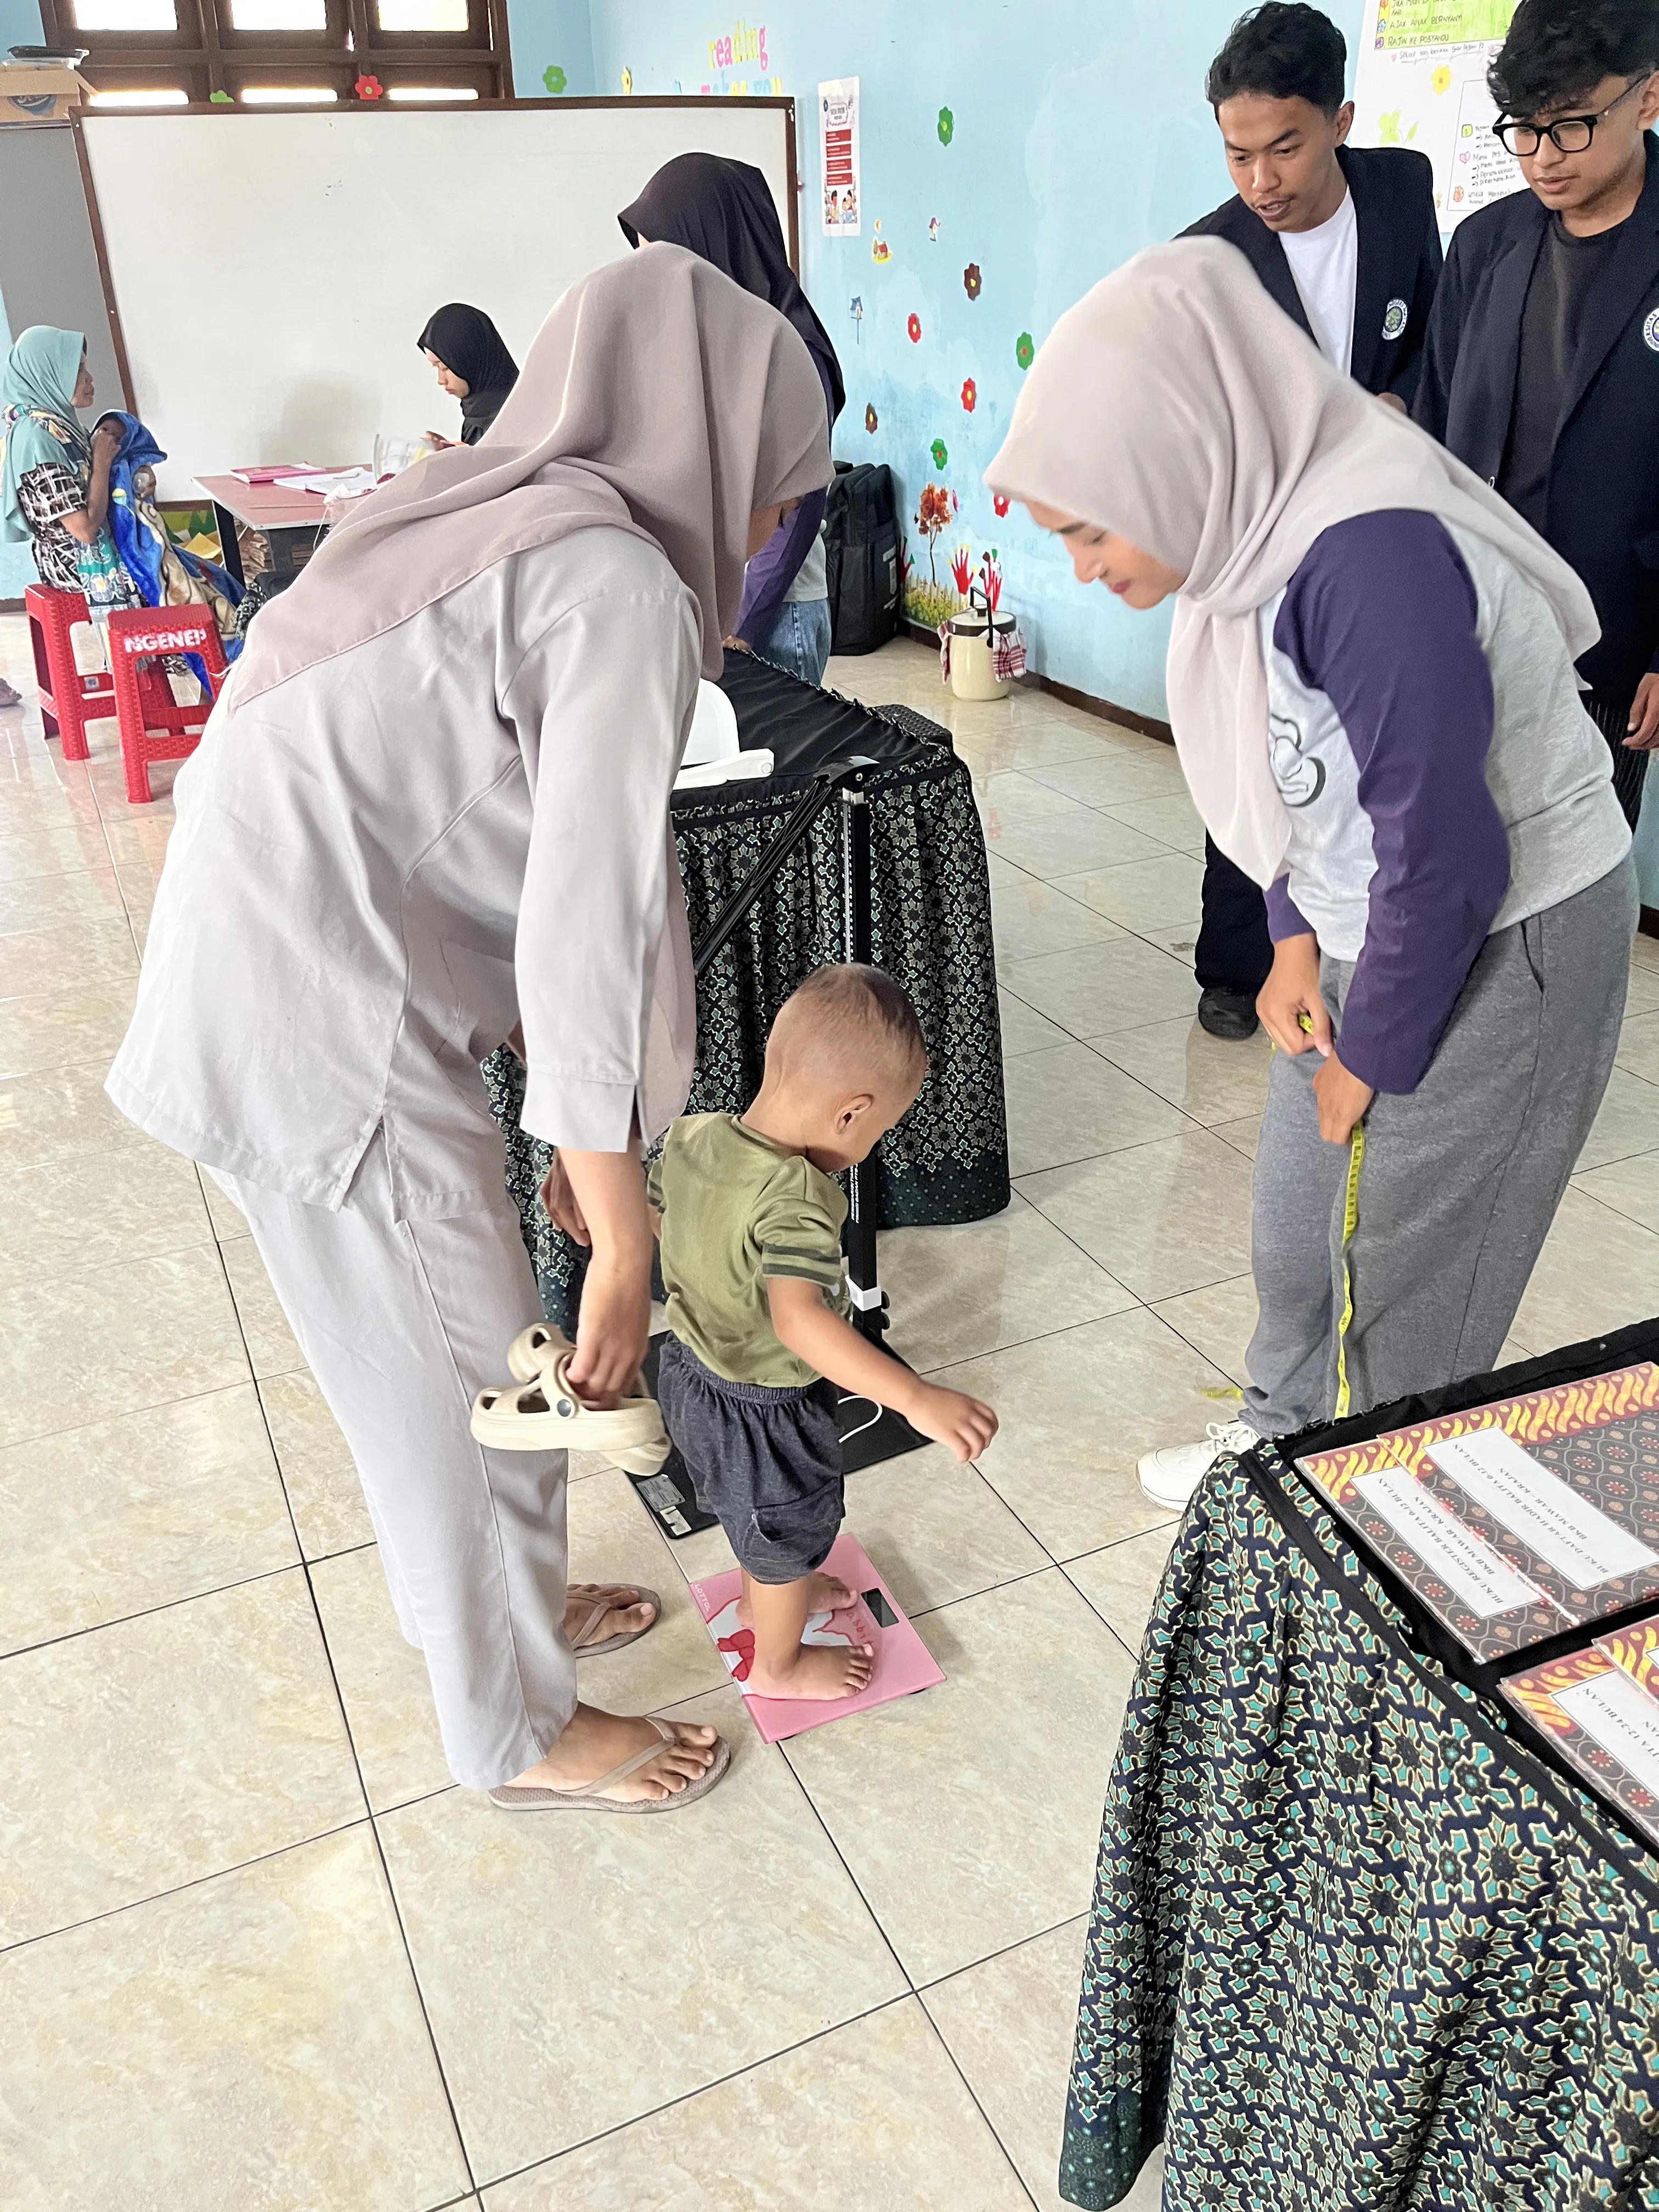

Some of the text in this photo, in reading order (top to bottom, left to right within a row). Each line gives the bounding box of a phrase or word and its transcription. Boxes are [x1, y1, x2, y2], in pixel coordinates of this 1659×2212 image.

[708, 18, 768, 71] reading
[1498, 1468, 1531, 1494] KRAJAN
[1414, 1496, 1444, 1525] KRAJAN
[1453, 1444, 1609, 1573] BUKU DAFTAR HADIR BALITA 0-12 BULAN
[1535, 1498, 1570, 1525] MAWAR
[1378, 1477, 1504, 1604] BUKU REGISTER BALITA 0-12 BULAN
[1447, 1528, 1480, 1559] MAWAR
[1568, 1525, 1588, 1540] BKB
[1476, 1559, 1495, 1576] BKB
[846, 1612, 874, 1645] abbit
[1583, 1687, 1659, 1763] ITA 12-24 BULAN
